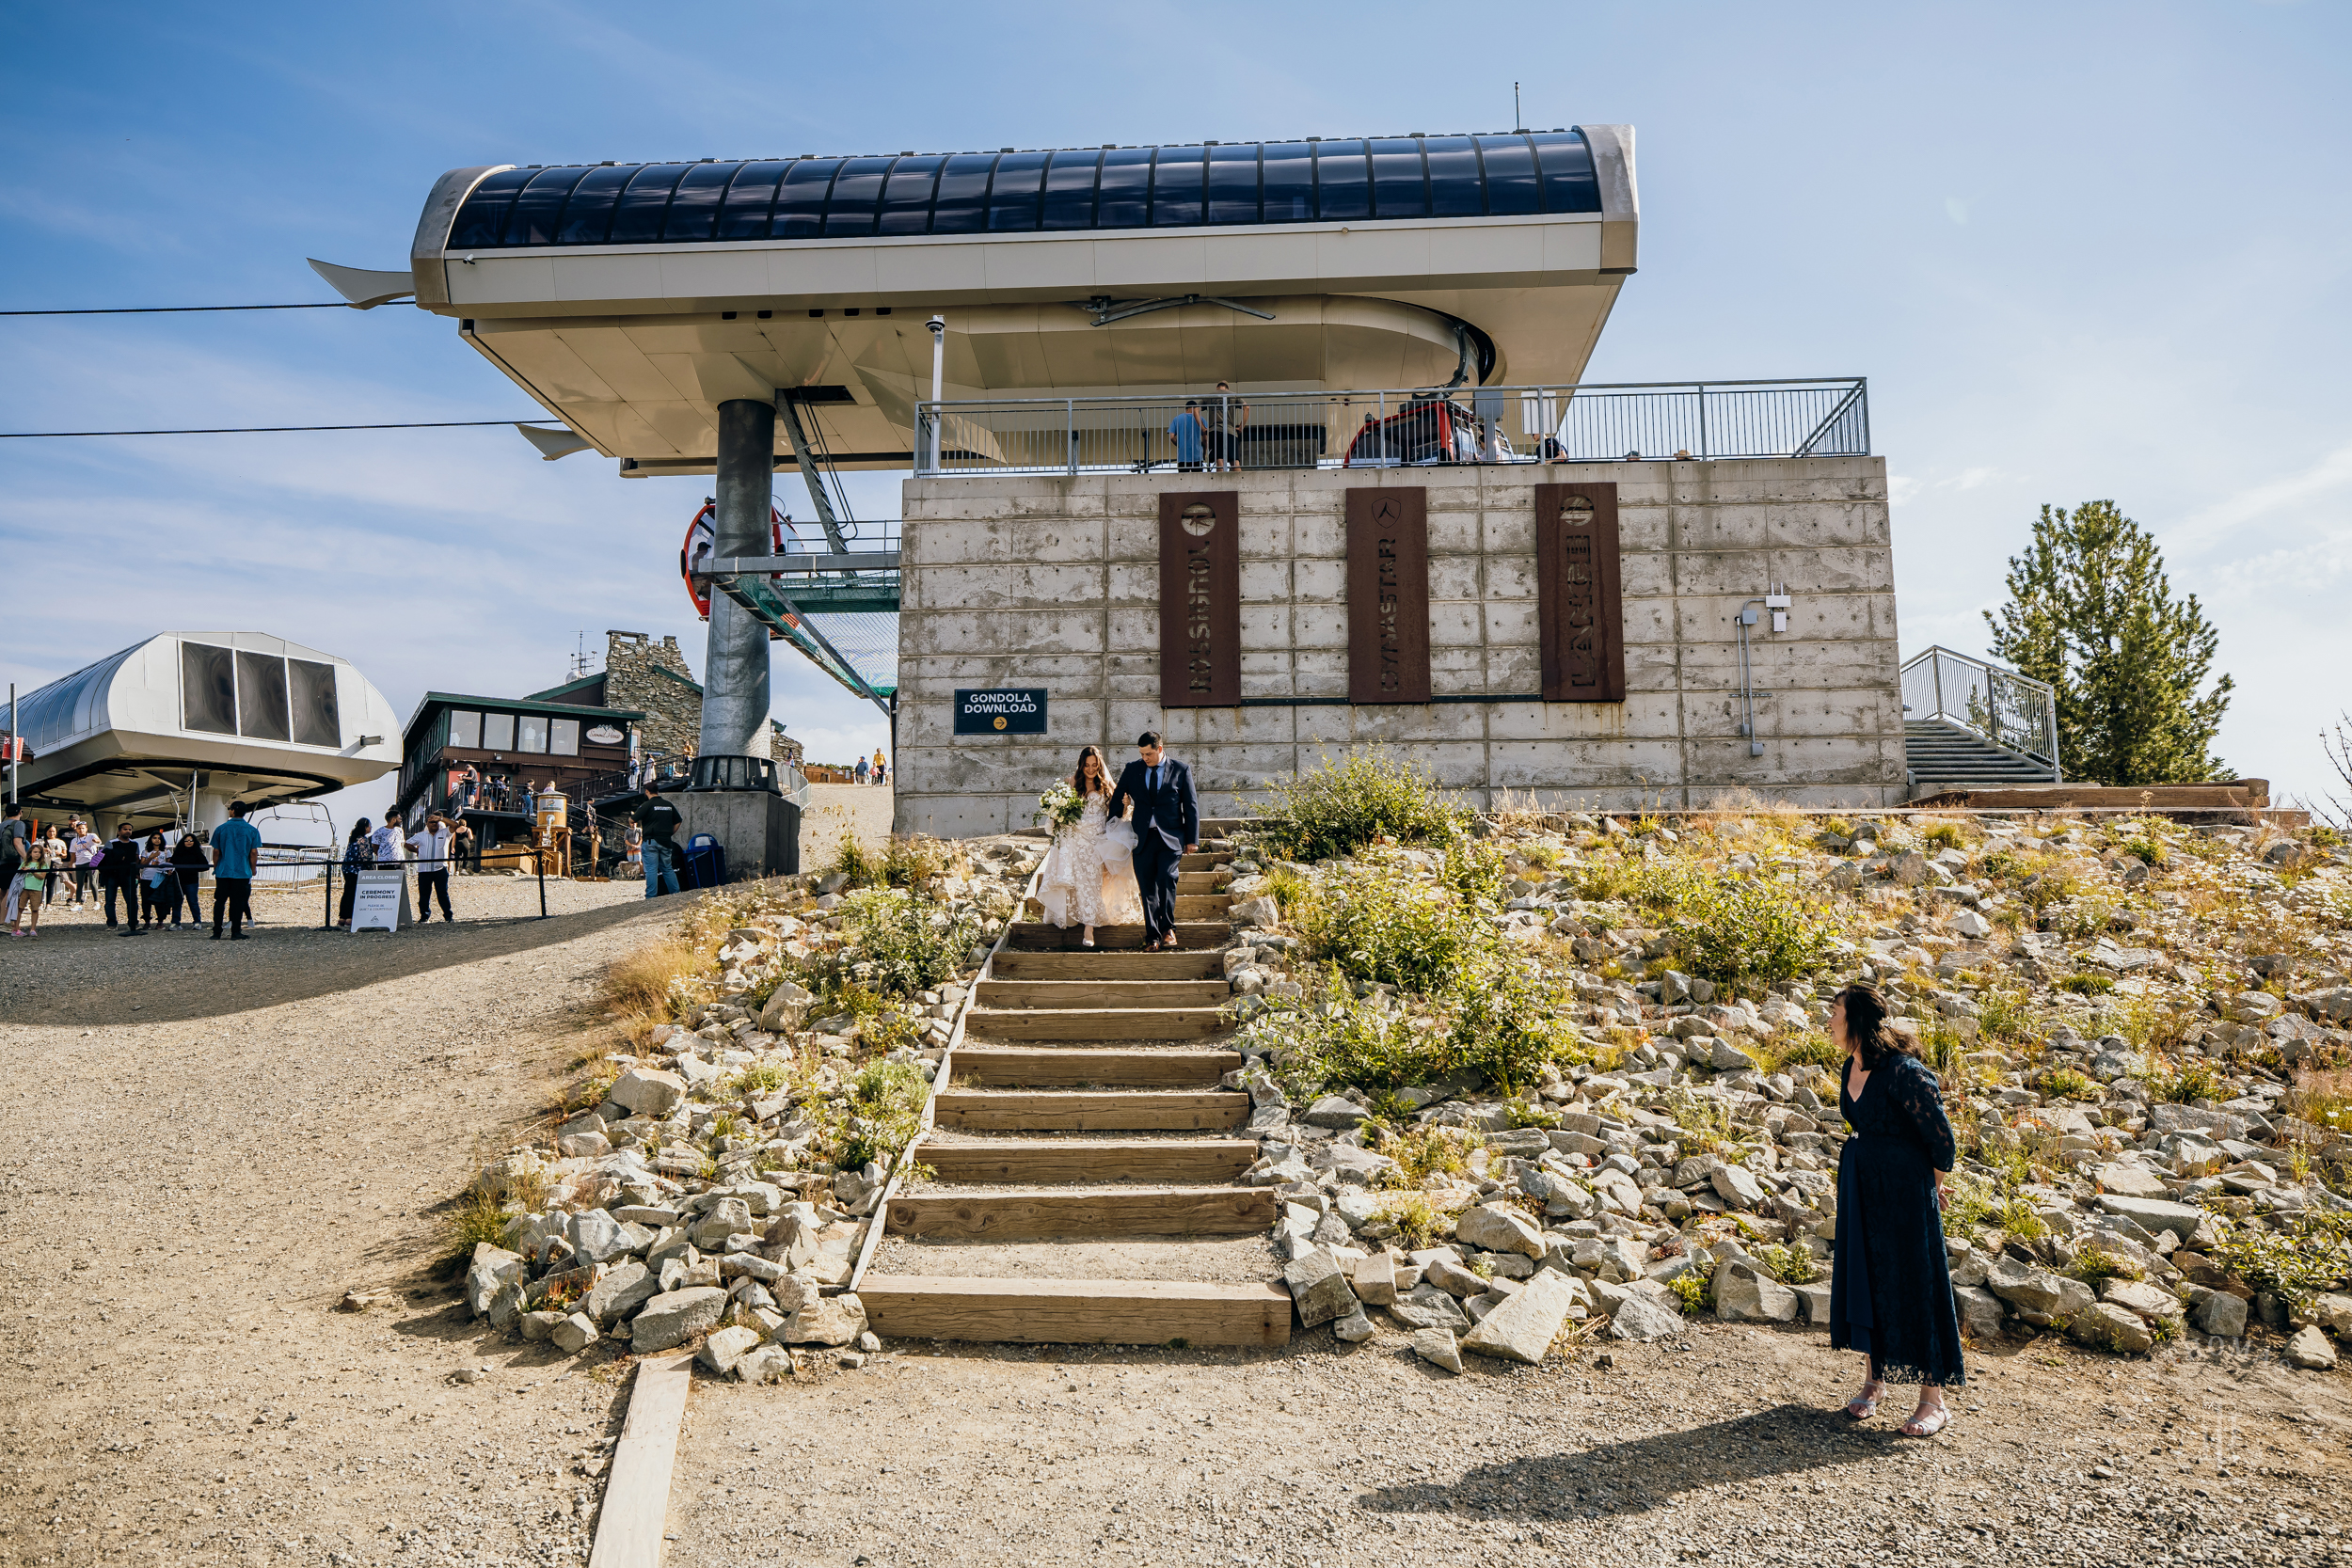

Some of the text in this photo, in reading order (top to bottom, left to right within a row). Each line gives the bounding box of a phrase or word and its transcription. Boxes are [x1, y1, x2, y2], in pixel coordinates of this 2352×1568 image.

[1188, 541, 1211, 693] ROSSIGNOL
[1379, 538, 1398, 691] DYNASTAR
[1566, 535, 1596, 687] LANGE
[964, 704, 1037, 713] DOWNLOAD
[970, 693, 1031, 703] GONDOLA
